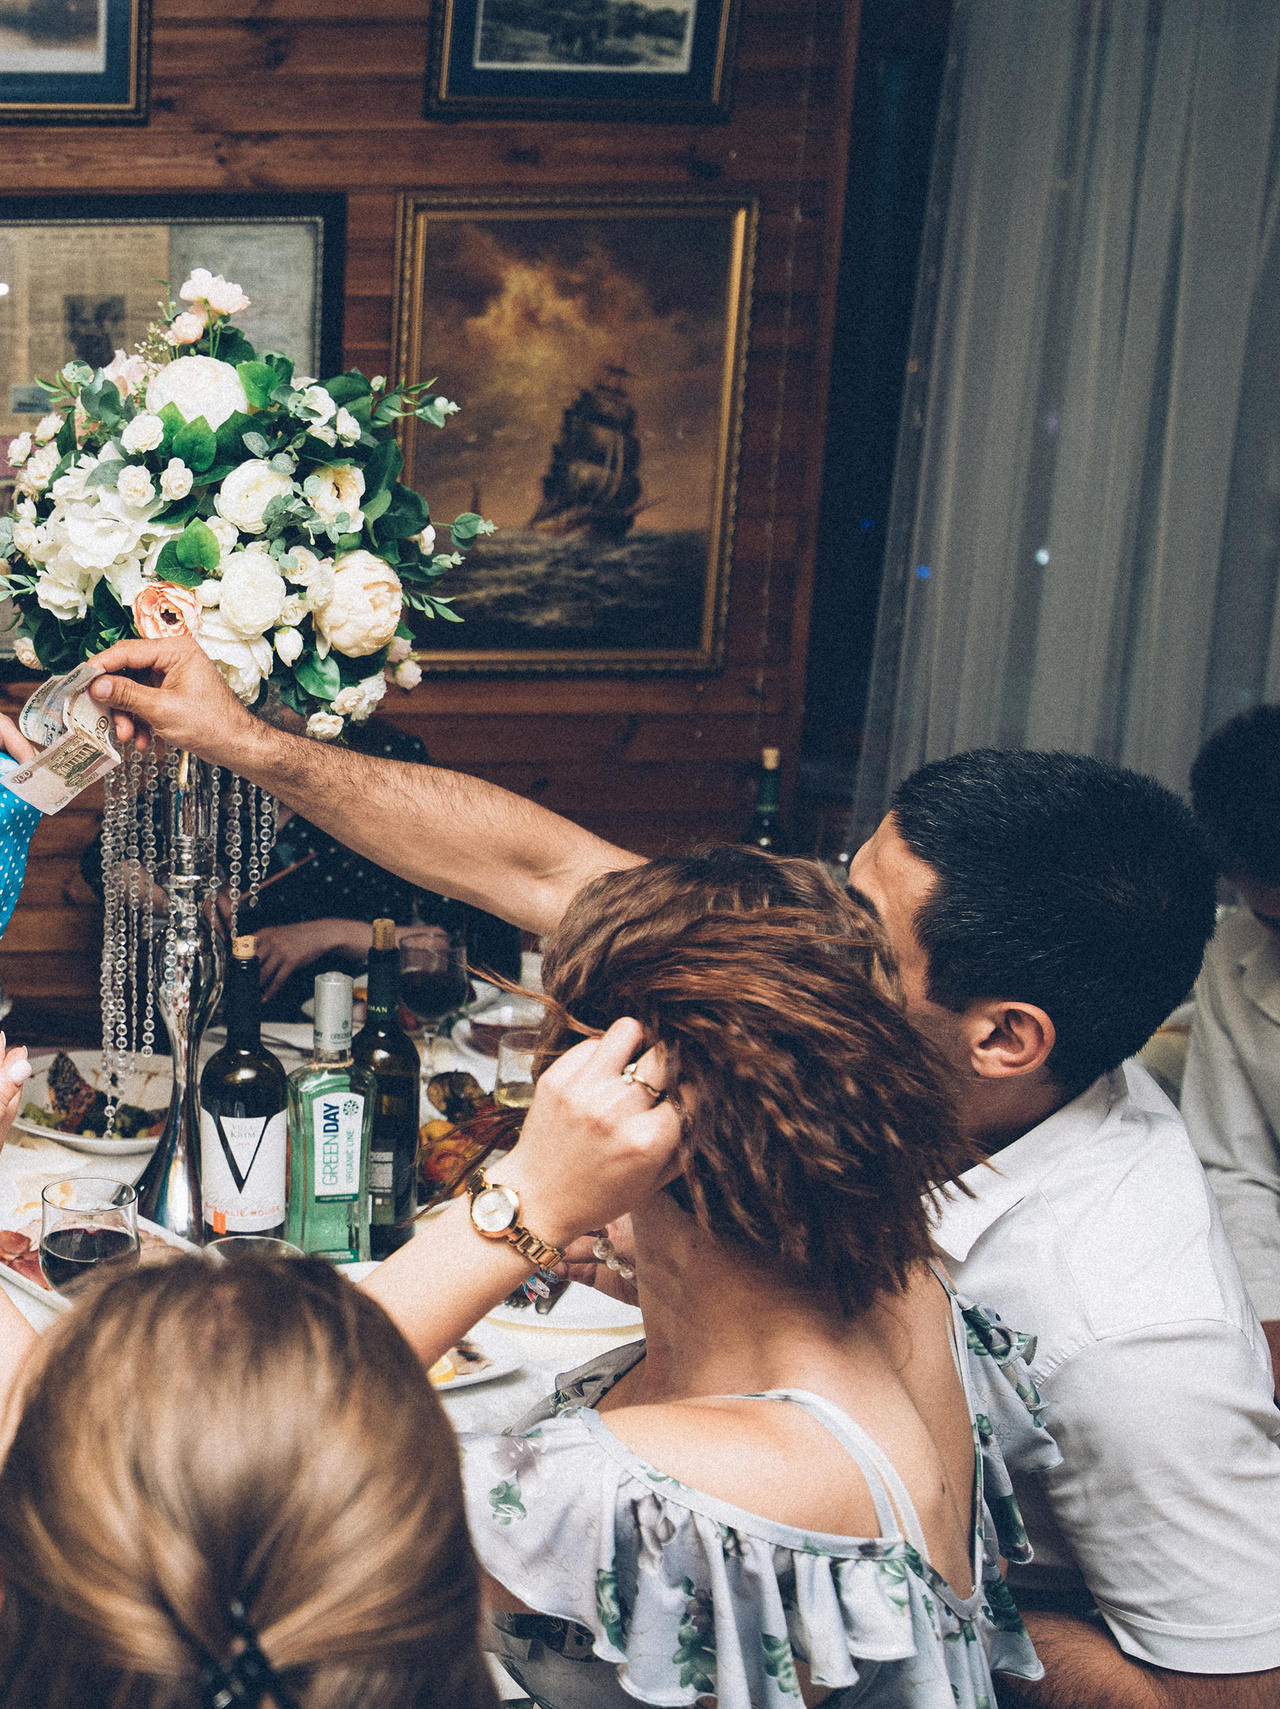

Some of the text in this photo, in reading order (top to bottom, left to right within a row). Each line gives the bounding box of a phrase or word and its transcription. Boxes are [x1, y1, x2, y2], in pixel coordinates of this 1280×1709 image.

[14, 770, 33, 784] 100
[322, 1103, 339, 1186] GREENDAY
[345, 1129, 355, 1184] ORGANIC LINE
